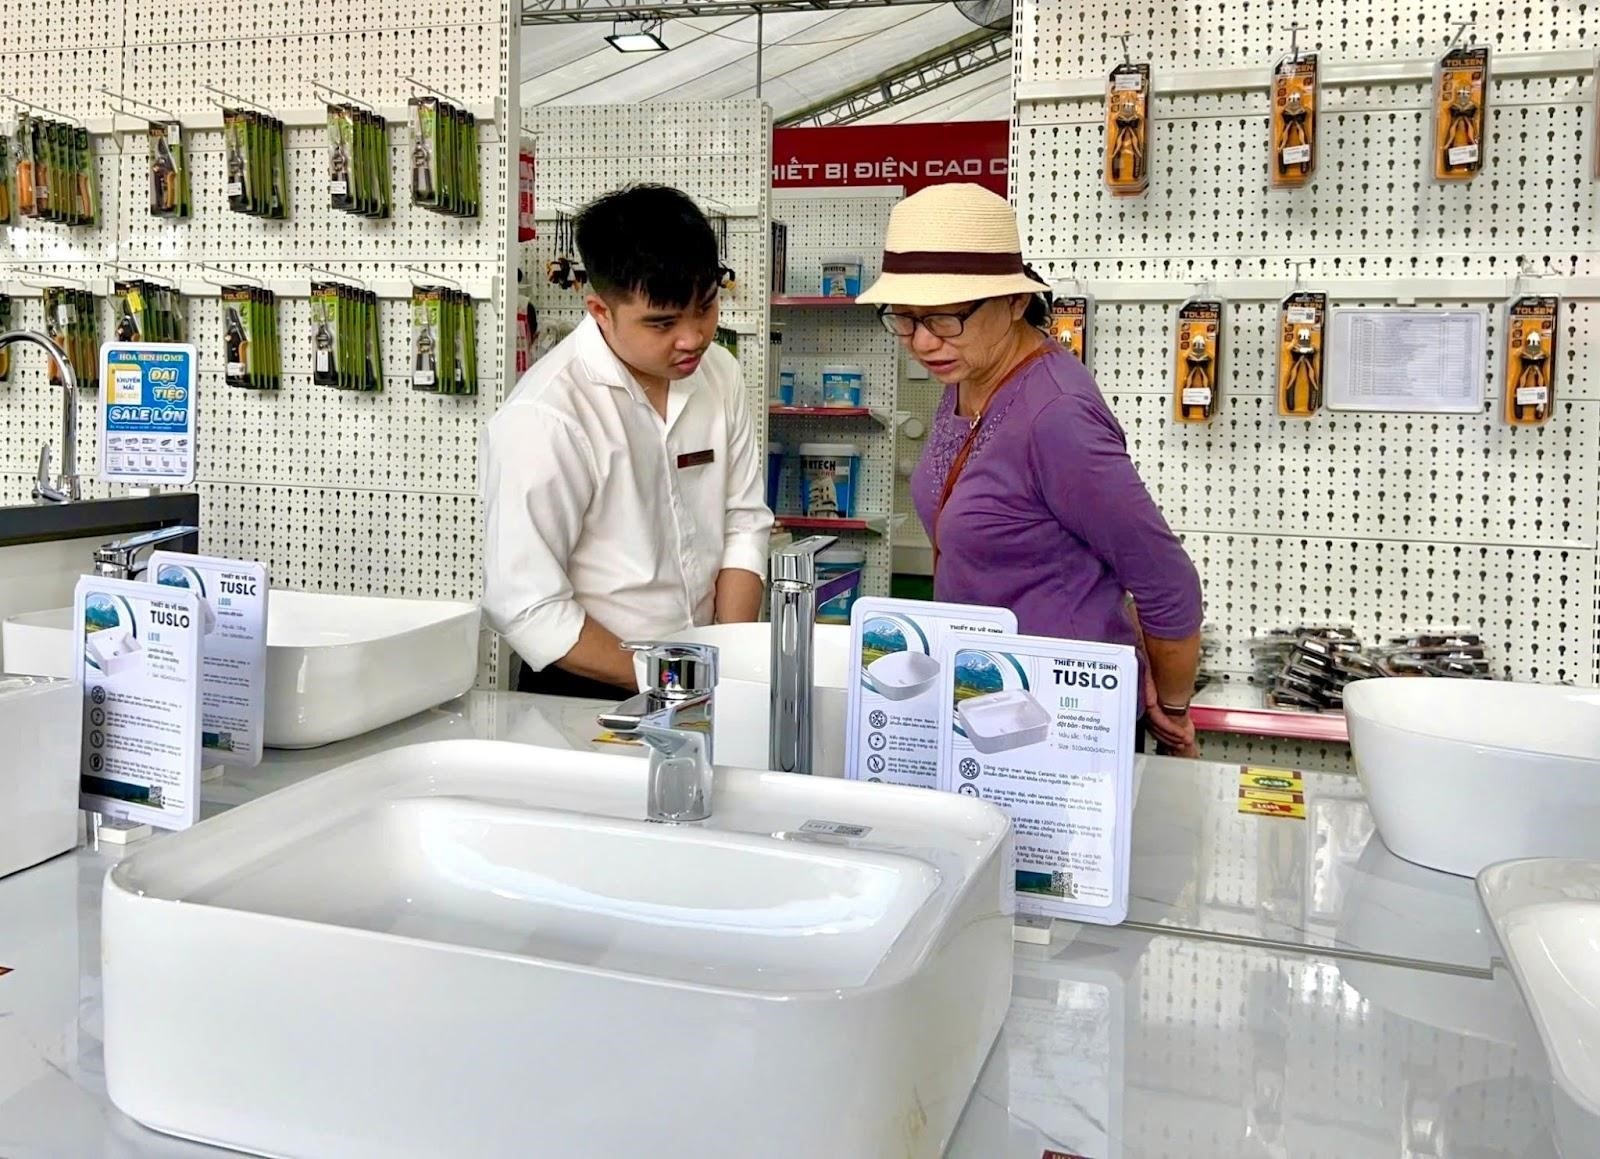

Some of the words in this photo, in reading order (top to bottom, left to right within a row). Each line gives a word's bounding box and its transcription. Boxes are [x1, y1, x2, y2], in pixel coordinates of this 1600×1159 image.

[825, 162, 848, 184] BỊ
[854, 156, 918, 183] ĐIỆN
[925, 158, 982, 177] CAO
[119, 353, 137, 361] HOA
[156, 353, 184, 362] HOME
[151, 368, 176, 384] ĐẠI
[155, 386, 185, 402] TIỆC
[112, 408, 150, 421] SALE
[154, 406, 186, 422] LỚN
[150, 610, 190, 629] TUSLO
[1054, 658, 1075, 667] THIẾT
[1077, 661, 1085, 669] BỊ
[1087, 661, 1097, 670] VỆ
[1099, 663, 1117, 671] SINH
[1053, 669, 1118, 690] TUSLO
[1060, 696, 1078, 708] L011
